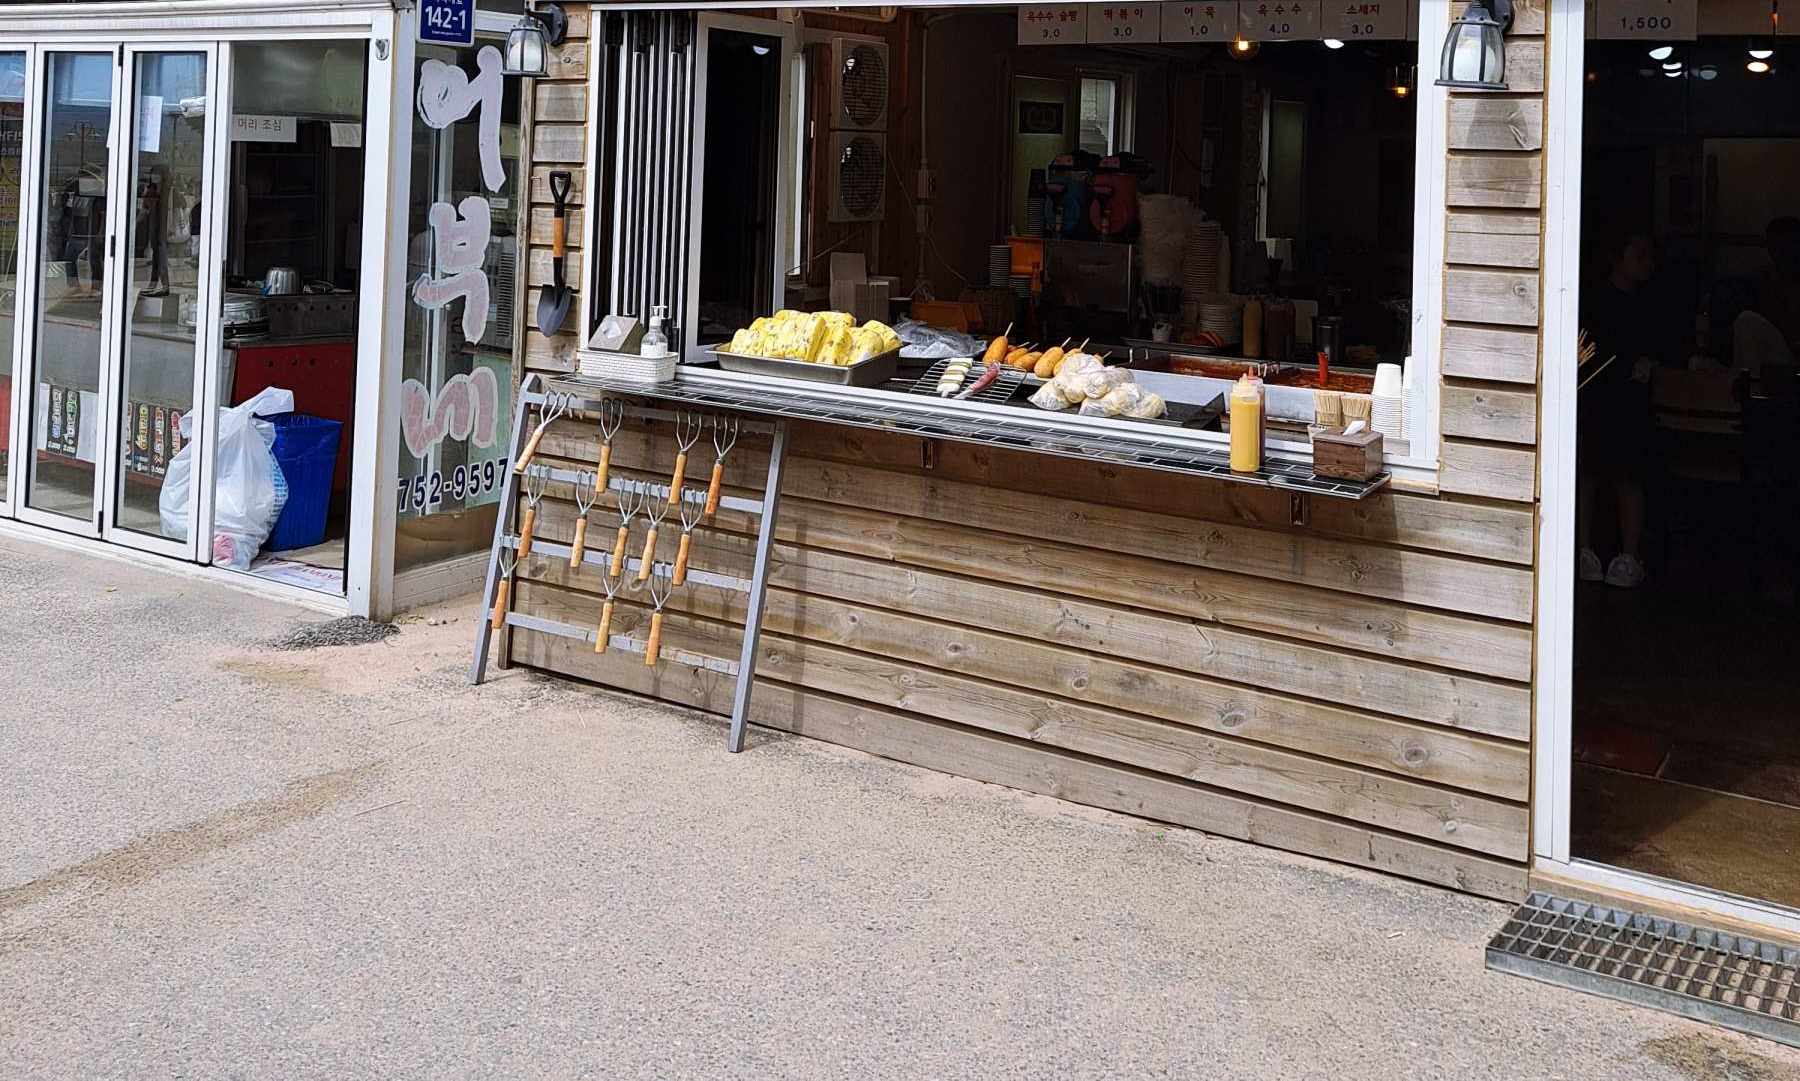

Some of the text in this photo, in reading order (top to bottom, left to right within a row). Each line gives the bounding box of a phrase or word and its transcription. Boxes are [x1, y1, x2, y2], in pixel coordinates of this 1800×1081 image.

[1257, 4, 1302, 17] 옥수수
[1346, 3, 1381, 16] 소세지
[425, 5, 466, 30] 142-1
[1620, 16, 1672, 32] 1,500
[1112, 26, 1133, 37] 3.0
[1189, 25, 1208, 36] 1.0
[1268, 23, 1290, 34] 4.0
[1351, 24, 1374, 35] 3.0
[237, 118, 258, 131] 머리
[398, 457, 508, 512] 752-9597
